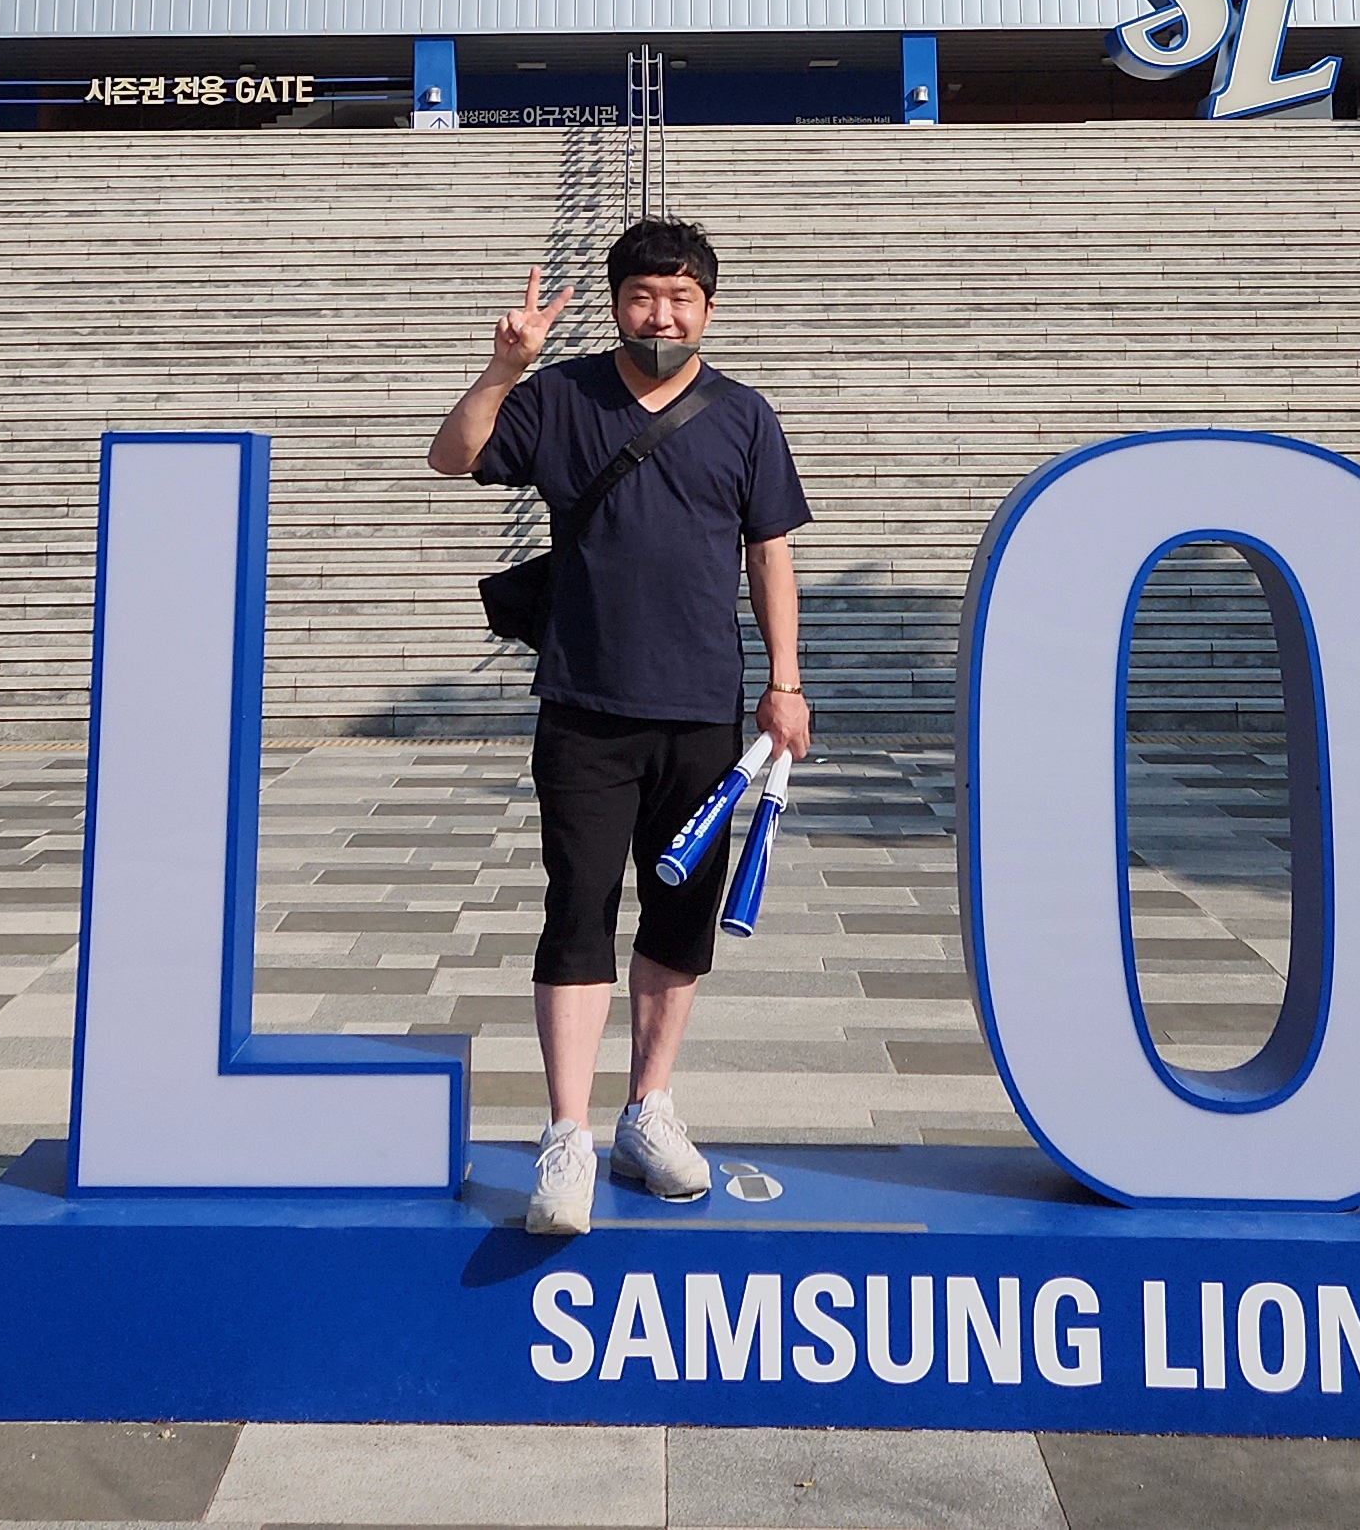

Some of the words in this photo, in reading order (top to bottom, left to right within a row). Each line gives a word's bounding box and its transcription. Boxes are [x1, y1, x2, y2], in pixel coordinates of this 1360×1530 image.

[85, 76, 165, 106] 시즌권
[172, 75, 227, 106] 전용
[235, 75, 315, 104] GATE
[458, 109, 520, 124] 삼성라이온즈
[523, 105, 619, 126] 야구전시관
[795, 116, 830, 124] Baseball
[833, 116, 872, 124] Exhibition
[873, 116, 891, 124] Hall
[529, 1271, 1103, 1388] SAMSUNG
